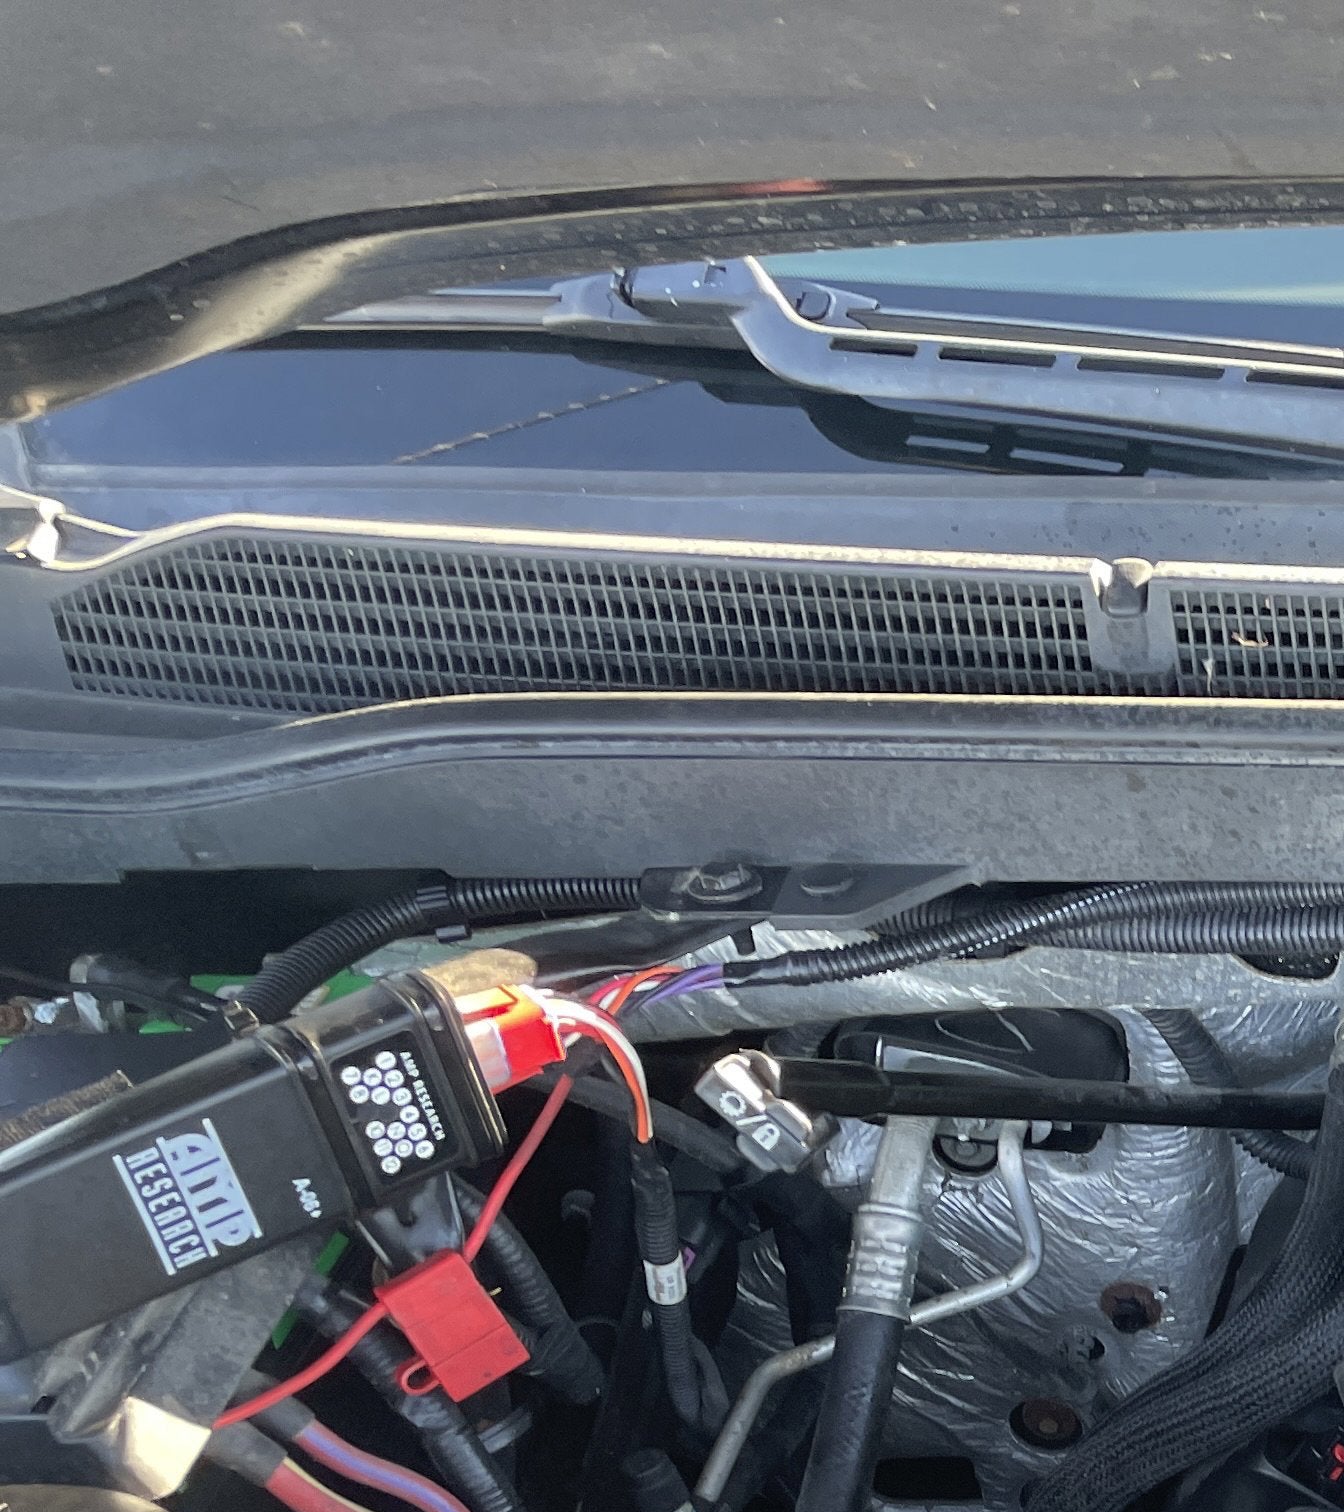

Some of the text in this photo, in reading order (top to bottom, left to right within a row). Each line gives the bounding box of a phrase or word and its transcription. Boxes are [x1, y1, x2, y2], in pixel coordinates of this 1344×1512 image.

[400, 1051, 446, 1141] AMP RESEARCH
[126, 1147, 207, 1269] RESEARCH
